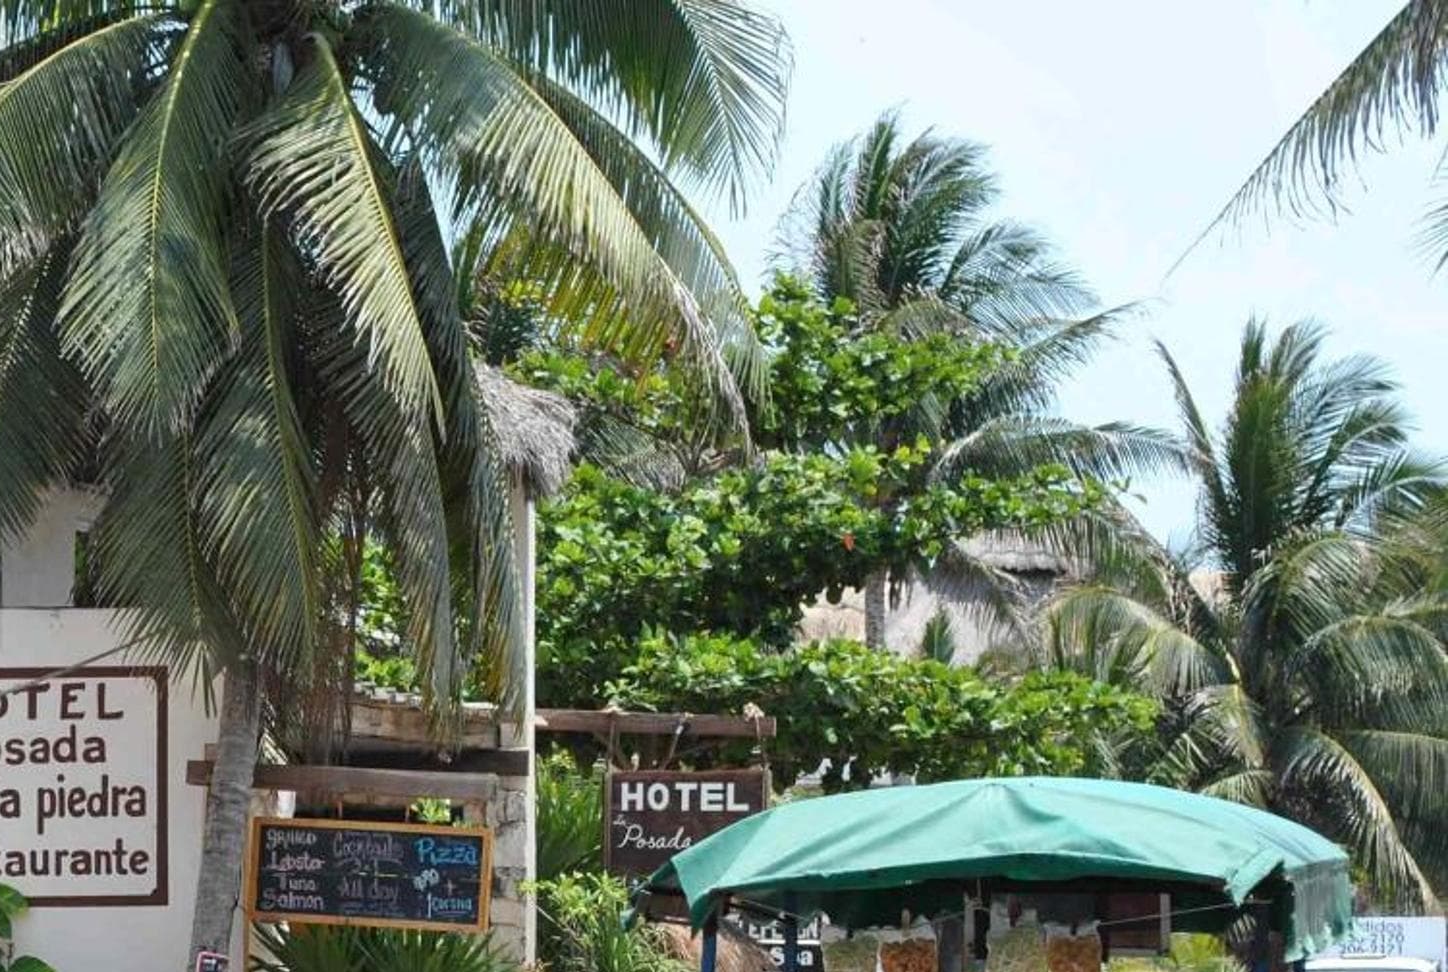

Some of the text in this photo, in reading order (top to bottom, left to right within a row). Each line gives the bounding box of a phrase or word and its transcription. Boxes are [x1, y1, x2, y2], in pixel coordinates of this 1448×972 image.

[37, 774, 147, 835] piedra
[620, 781, 750, 812] HOTEL
[617, 824, 692, 850] Posada
[770, 946, 813, 967] Sa
